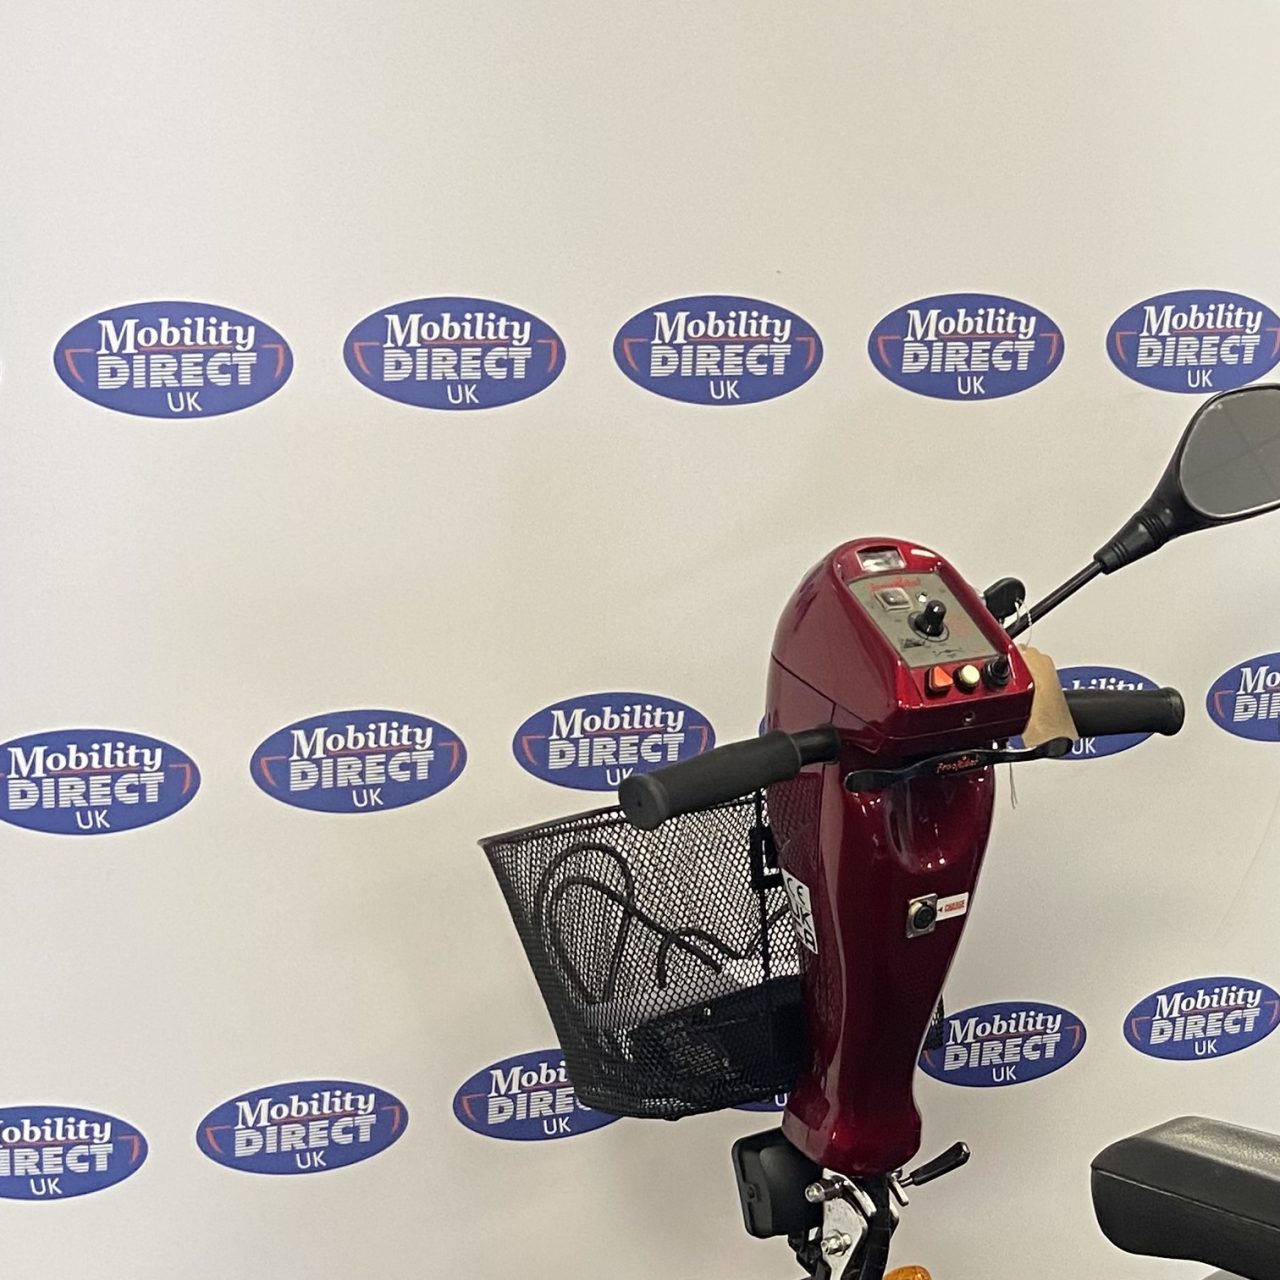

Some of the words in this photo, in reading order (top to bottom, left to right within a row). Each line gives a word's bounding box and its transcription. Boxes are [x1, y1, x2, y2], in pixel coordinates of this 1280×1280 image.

[96, 318, 256, 353] Mobility
[384, 313, 531, 348] Mobility
[651, 310, 791, 344] Mobility
[903, 308, 1036, 342] Mobility
[1142, 303, 1263, 339] Mobility
[383, 346, 532, 380] DIRECT
[650, 344, 791, 377] DIRECT
[902, 339, 1035, 373] DIRECT
[1137, 334, 1261, 367] DIRECT
[97, 353, 257, 389] DIRECT
[956, 374, 986, 395] UK
[1187, 369, 1213, 389] UK
[167, 391, 202, 413] UK
[447, 384, 479, 405] UK
[709, 379, 740, 399] UK
[550, 704, 685, 740] Mobility
[290, 723, 434, 760] Mobility
[548, 733, 685, 769] DIRECT
[7, 742, 163, 779] Mobility
[289, 754, 435, 792] DIRECT
[8, 772, 165, 810] DIRECT
[352, 787, 384, 807] UK
[75, 810, 111, 830] UK
[1155, 987, 1264, 1020] Mobility
[946, 1010, 1062, 1045] Mobility
[1150, 1008, 1261, 1045] DIRECT
[944, 1033, 1061, 1071] DIRECT
[1194, 1038, 1218, 1057] UK
[487, 1060, 568, 1097] Mobi
[992, 1065, 1017, 1082] UK
[236, 1092, 376, 1129] Mobility
[487, 1087, 591, 1124] DIRE
[0, 1117, 111, 1148] obility
[234, 1119, 376, 1157] DIRECT
[543, 1116, 571, 1135] UK
[0, 1143, 113, 1177] IRECT
[295, 1150, 327, 1170] UK
[30, 1178, 62, 1196] UK
